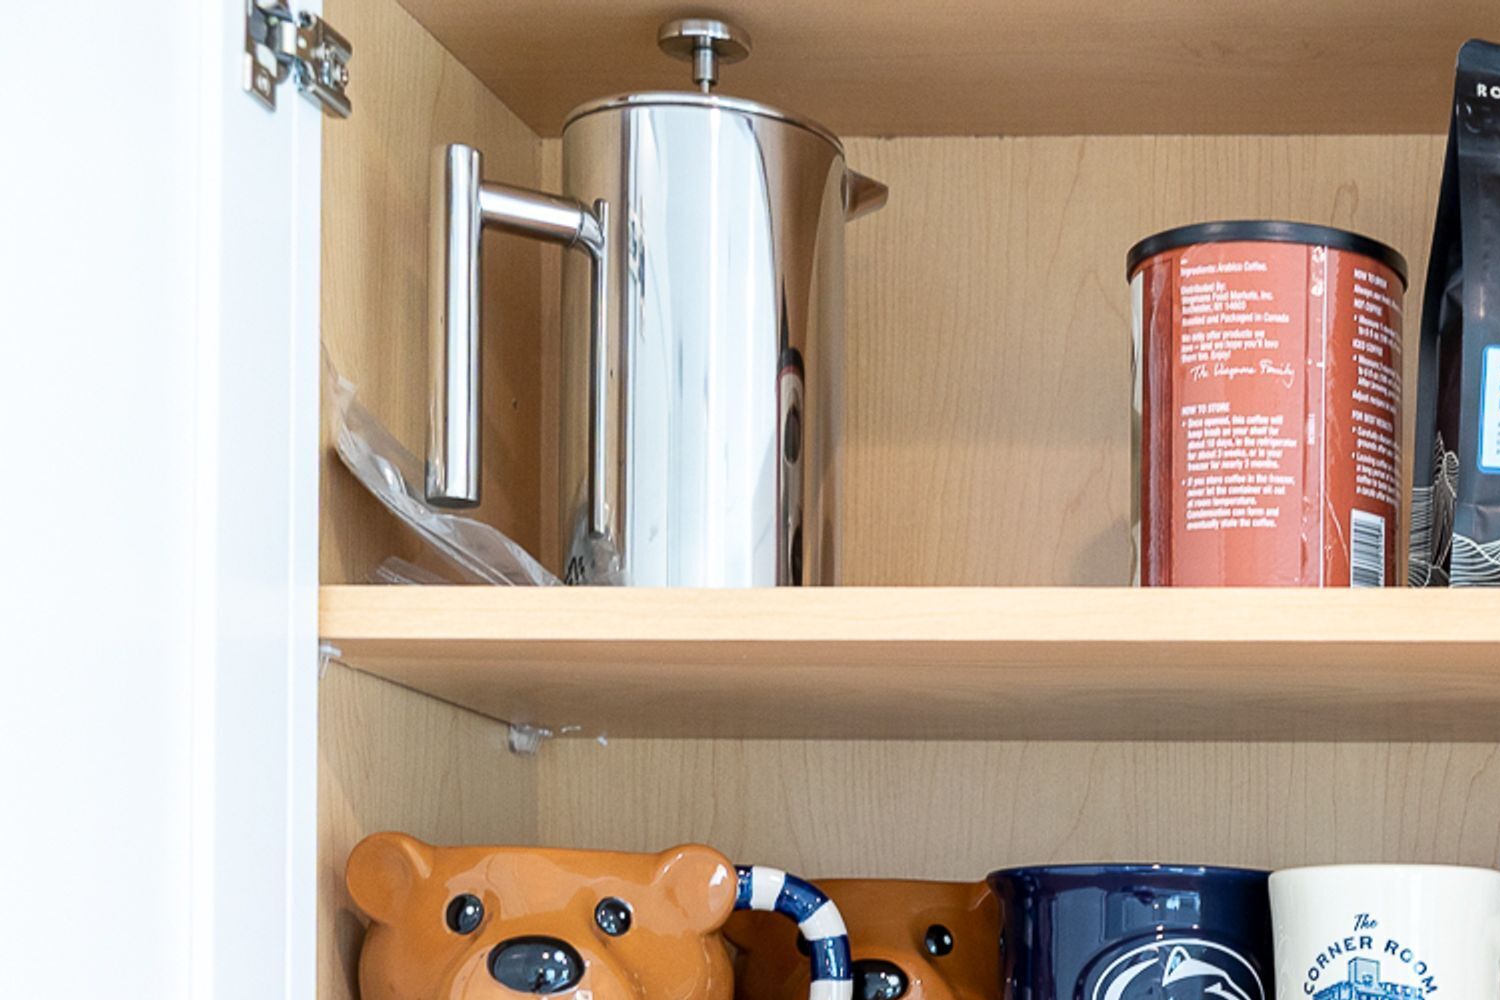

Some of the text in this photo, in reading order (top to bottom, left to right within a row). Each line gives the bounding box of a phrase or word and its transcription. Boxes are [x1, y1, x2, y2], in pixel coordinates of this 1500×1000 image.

[1353, 913, 1379, 932] The
[1303, 935, 1438, 995] CORNER ROOM
